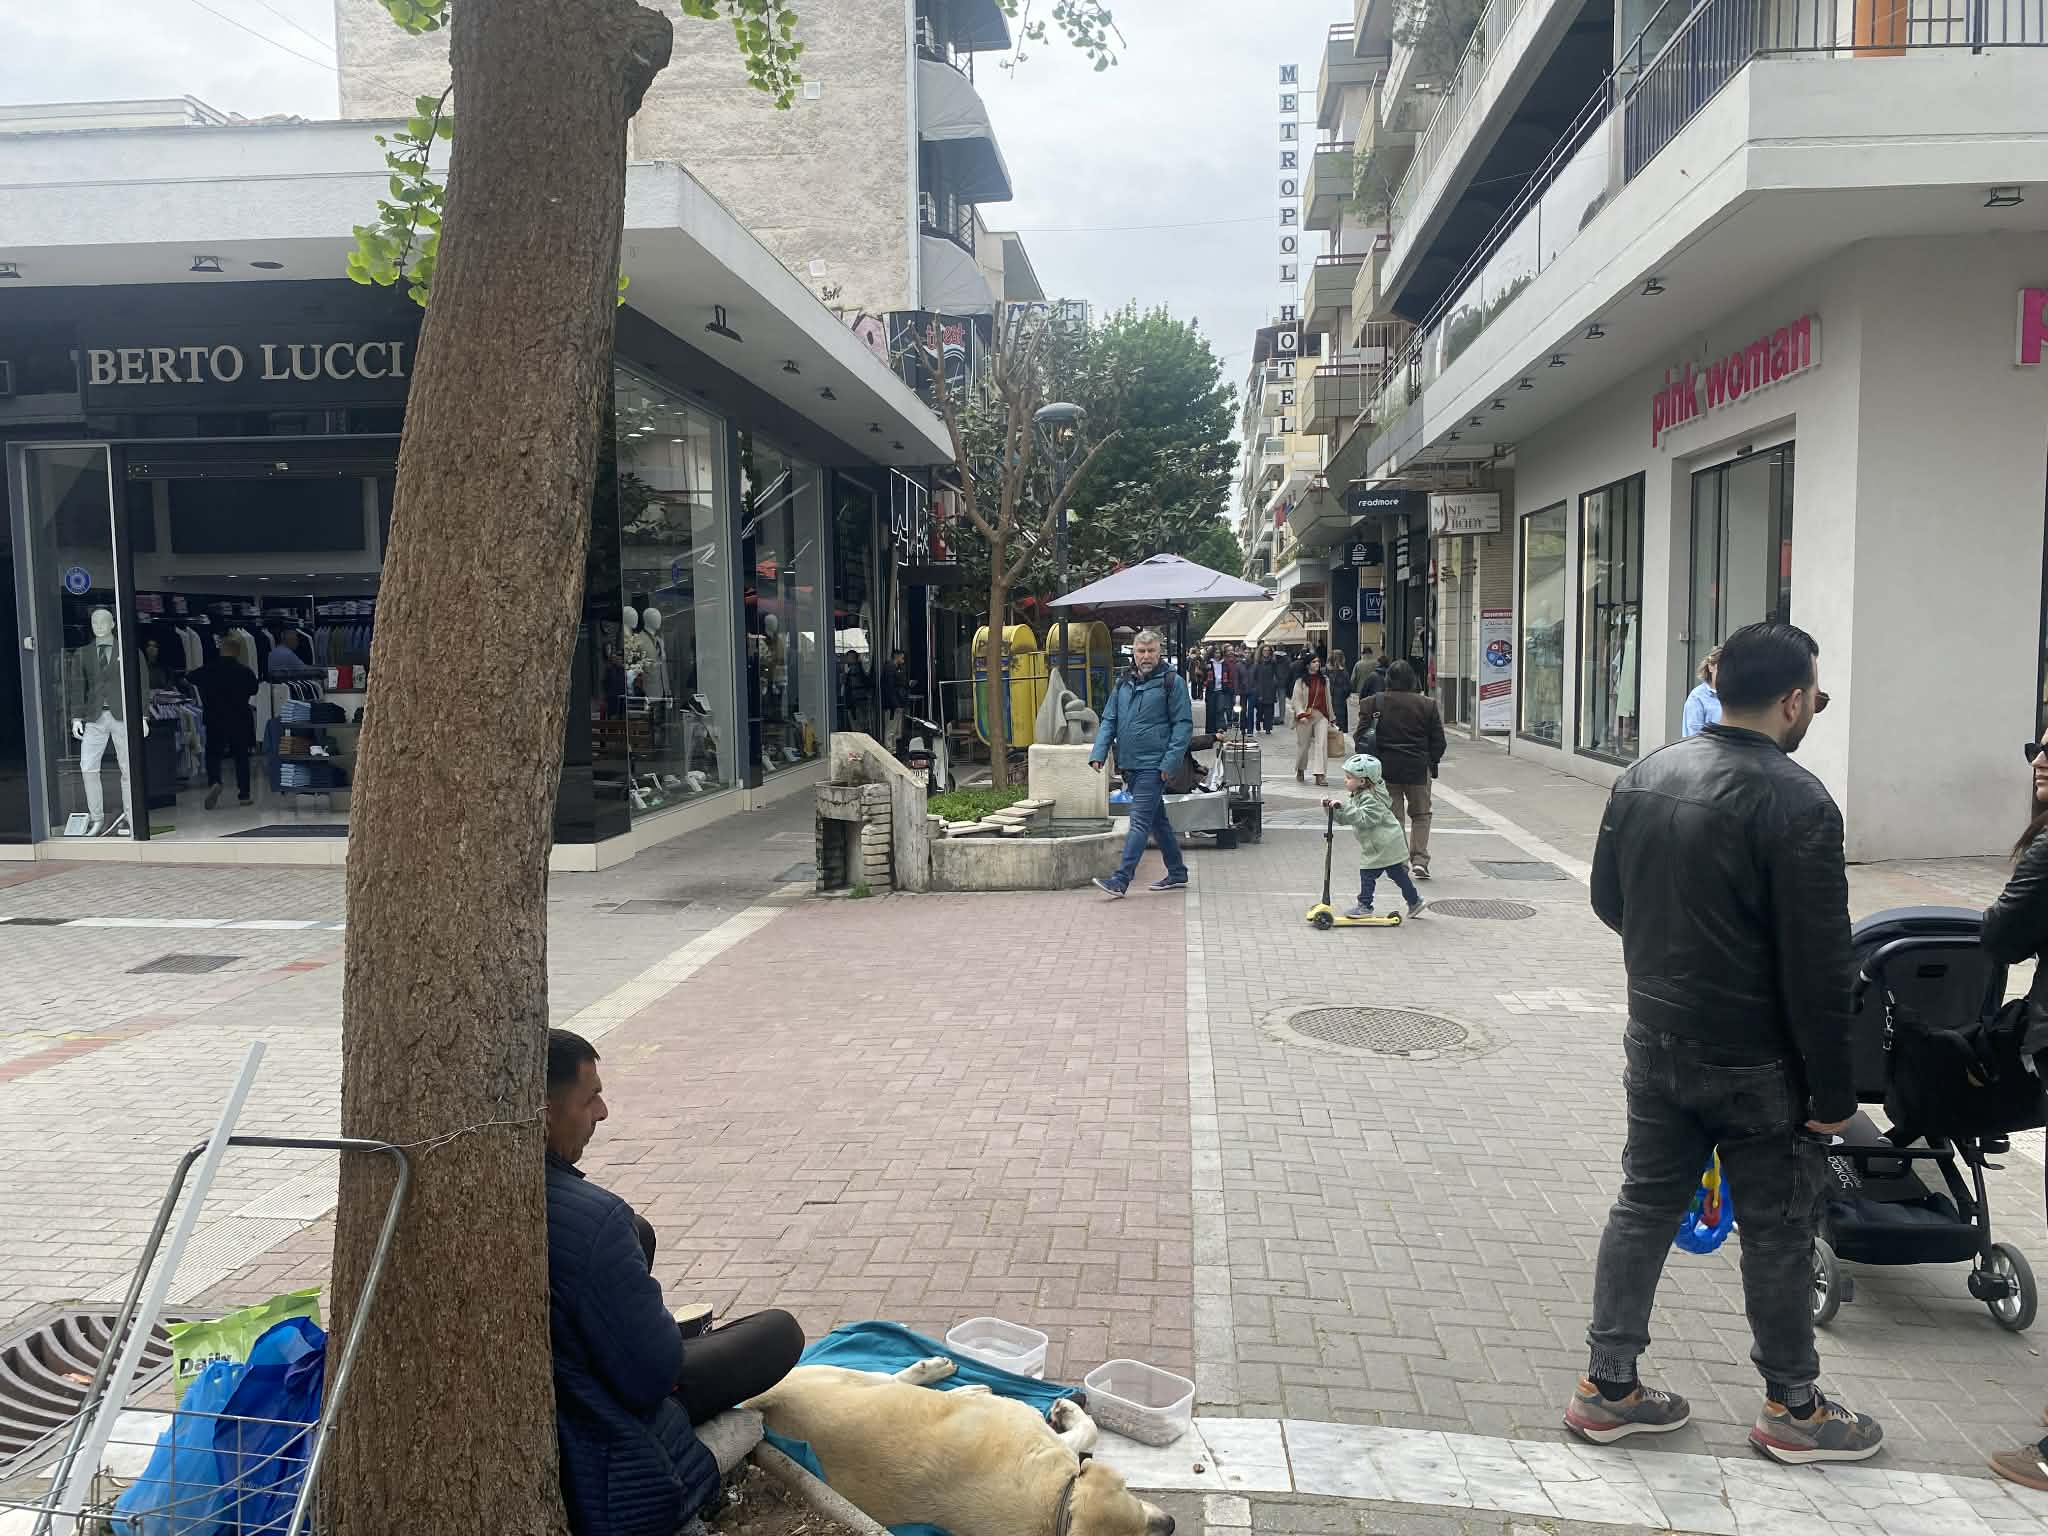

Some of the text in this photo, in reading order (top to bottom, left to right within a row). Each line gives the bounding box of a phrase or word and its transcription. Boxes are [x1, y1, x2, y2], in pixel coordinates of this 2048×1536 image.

[1280, 66, 1296, 433] METROPOL HOTEL
[88, 341, 405, 385] BERTO LUCCI
[1652, 314, 1811, 448] pink woman
[1358, 498, 1400, 507] readmore
